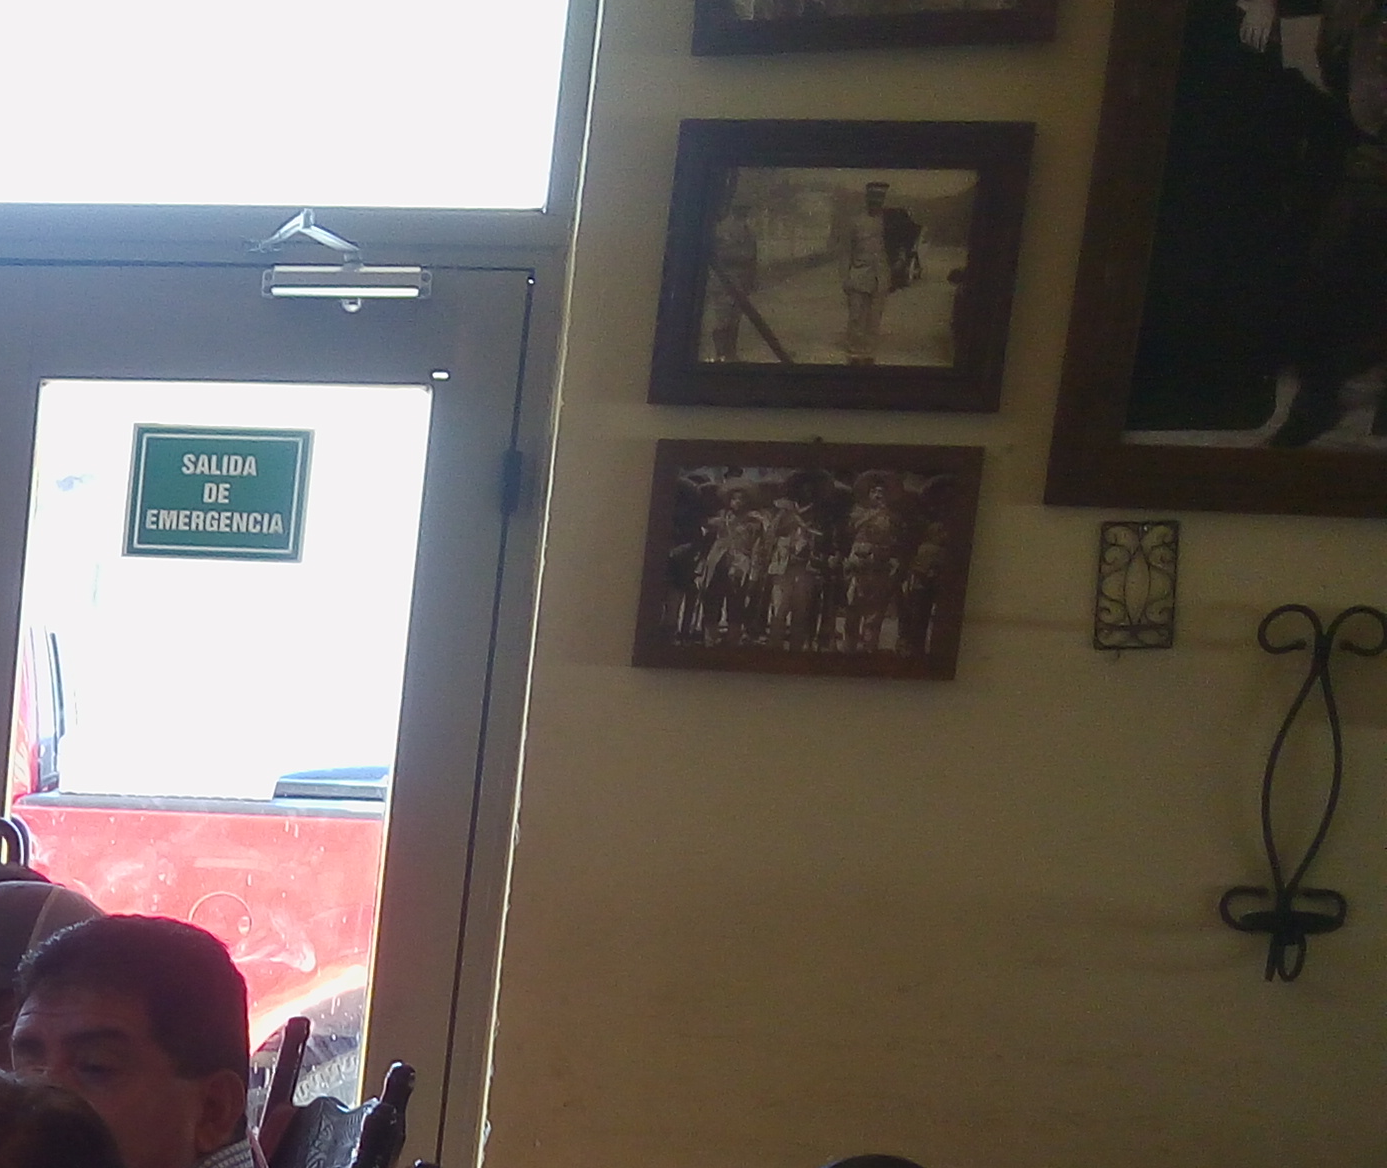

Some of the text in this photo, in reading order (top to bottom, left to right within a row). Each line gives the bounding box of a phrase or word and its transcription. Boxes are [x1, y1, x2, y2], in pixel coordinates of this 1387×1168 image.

[181, 453, 257, 476] SALIDA
[202, 482, 231, 504] DE
[145, 509, 284, 534] EMERGENCIA
